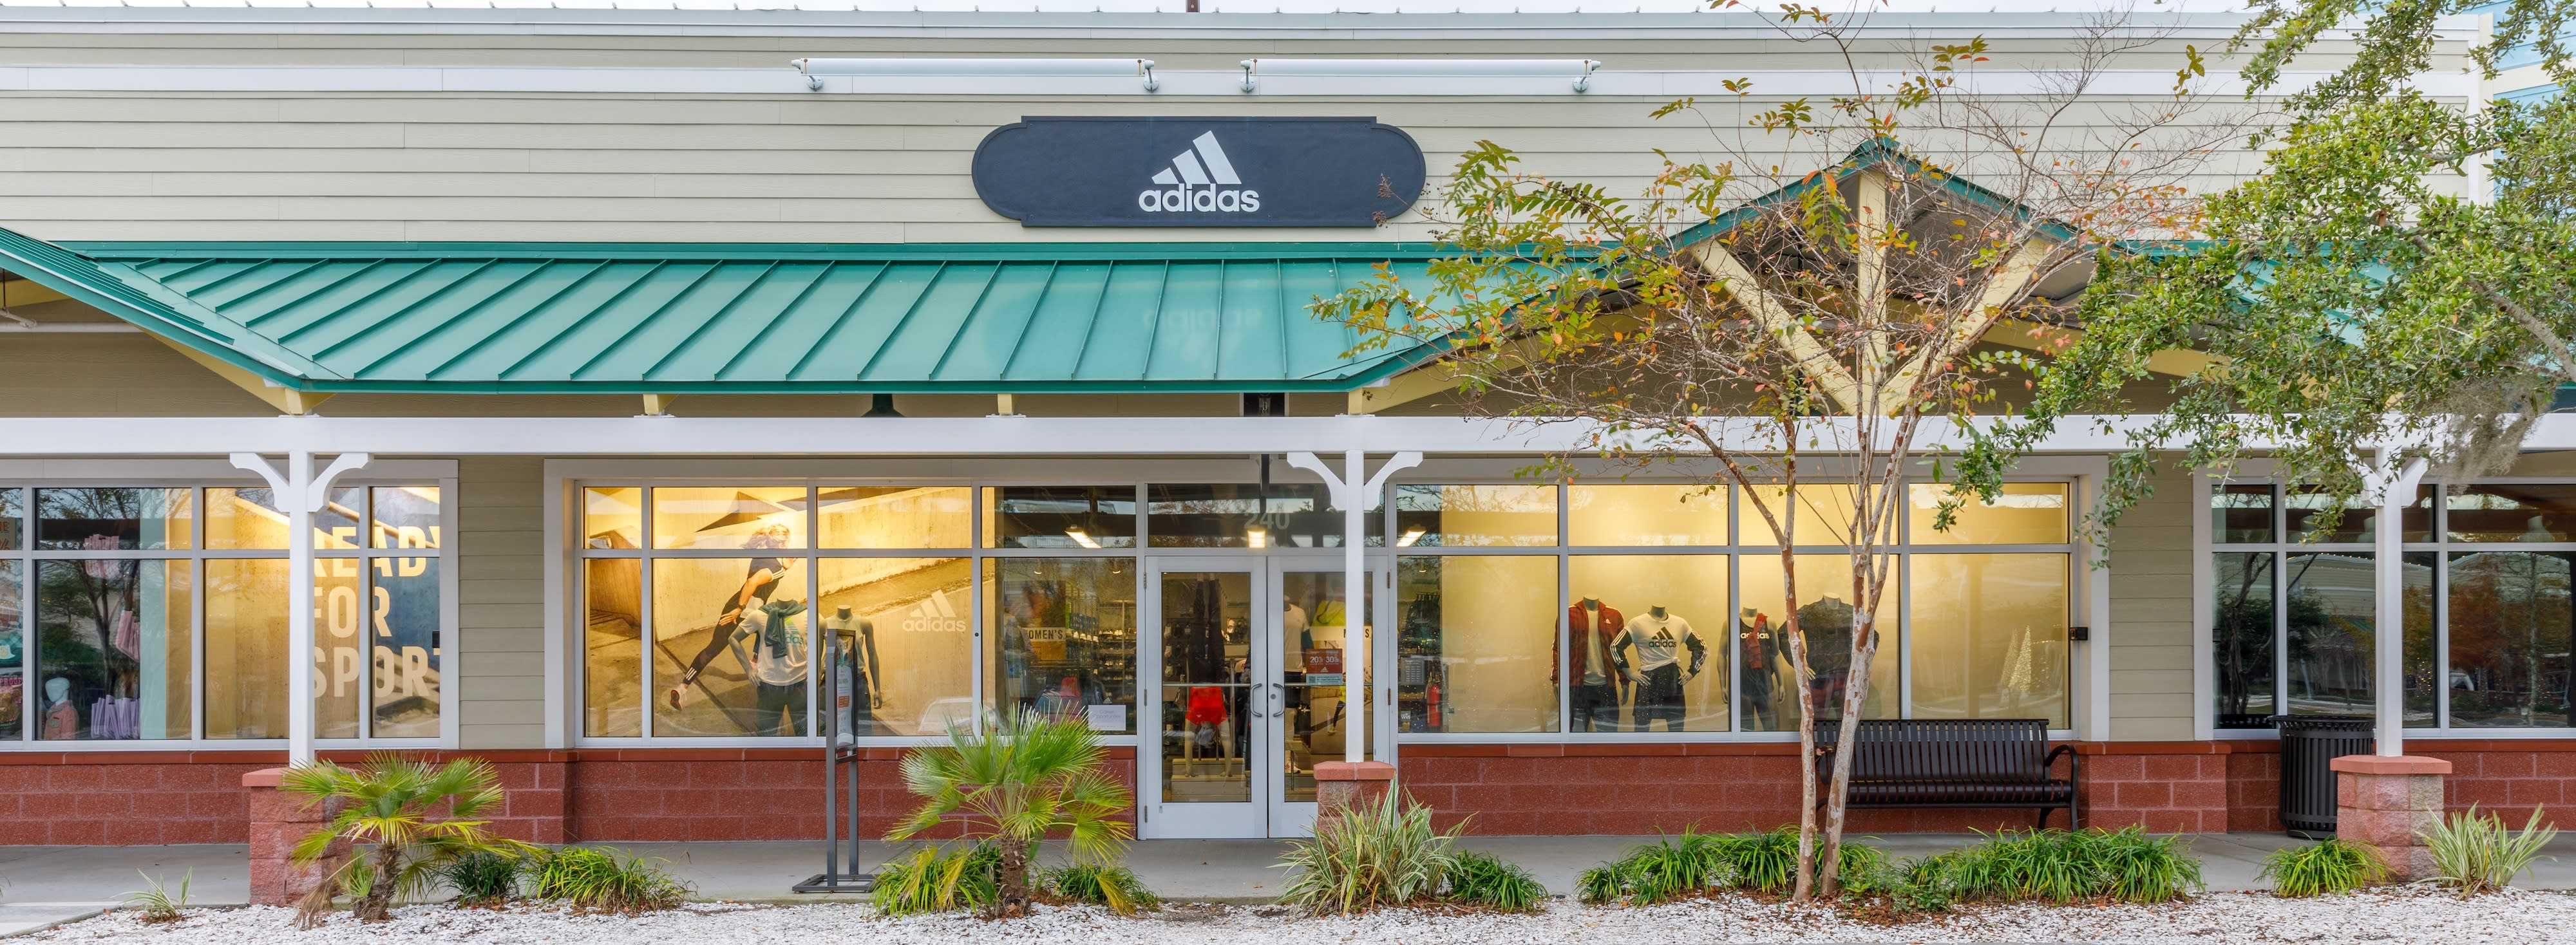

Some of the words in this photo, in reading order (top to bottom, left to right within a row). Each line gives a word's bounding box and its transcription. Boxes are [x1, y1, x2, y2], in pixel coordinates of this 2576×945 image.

[1139, 183, 1260, 212] adidas
[1244, 509, 1290, 530] 240
[902, 617, 966, 632] adidas
[1028, 630, 1063, 639] OMEN'S
[1649, 638, 1677, 648] adidas
[314, 645, 440, 698] POR
